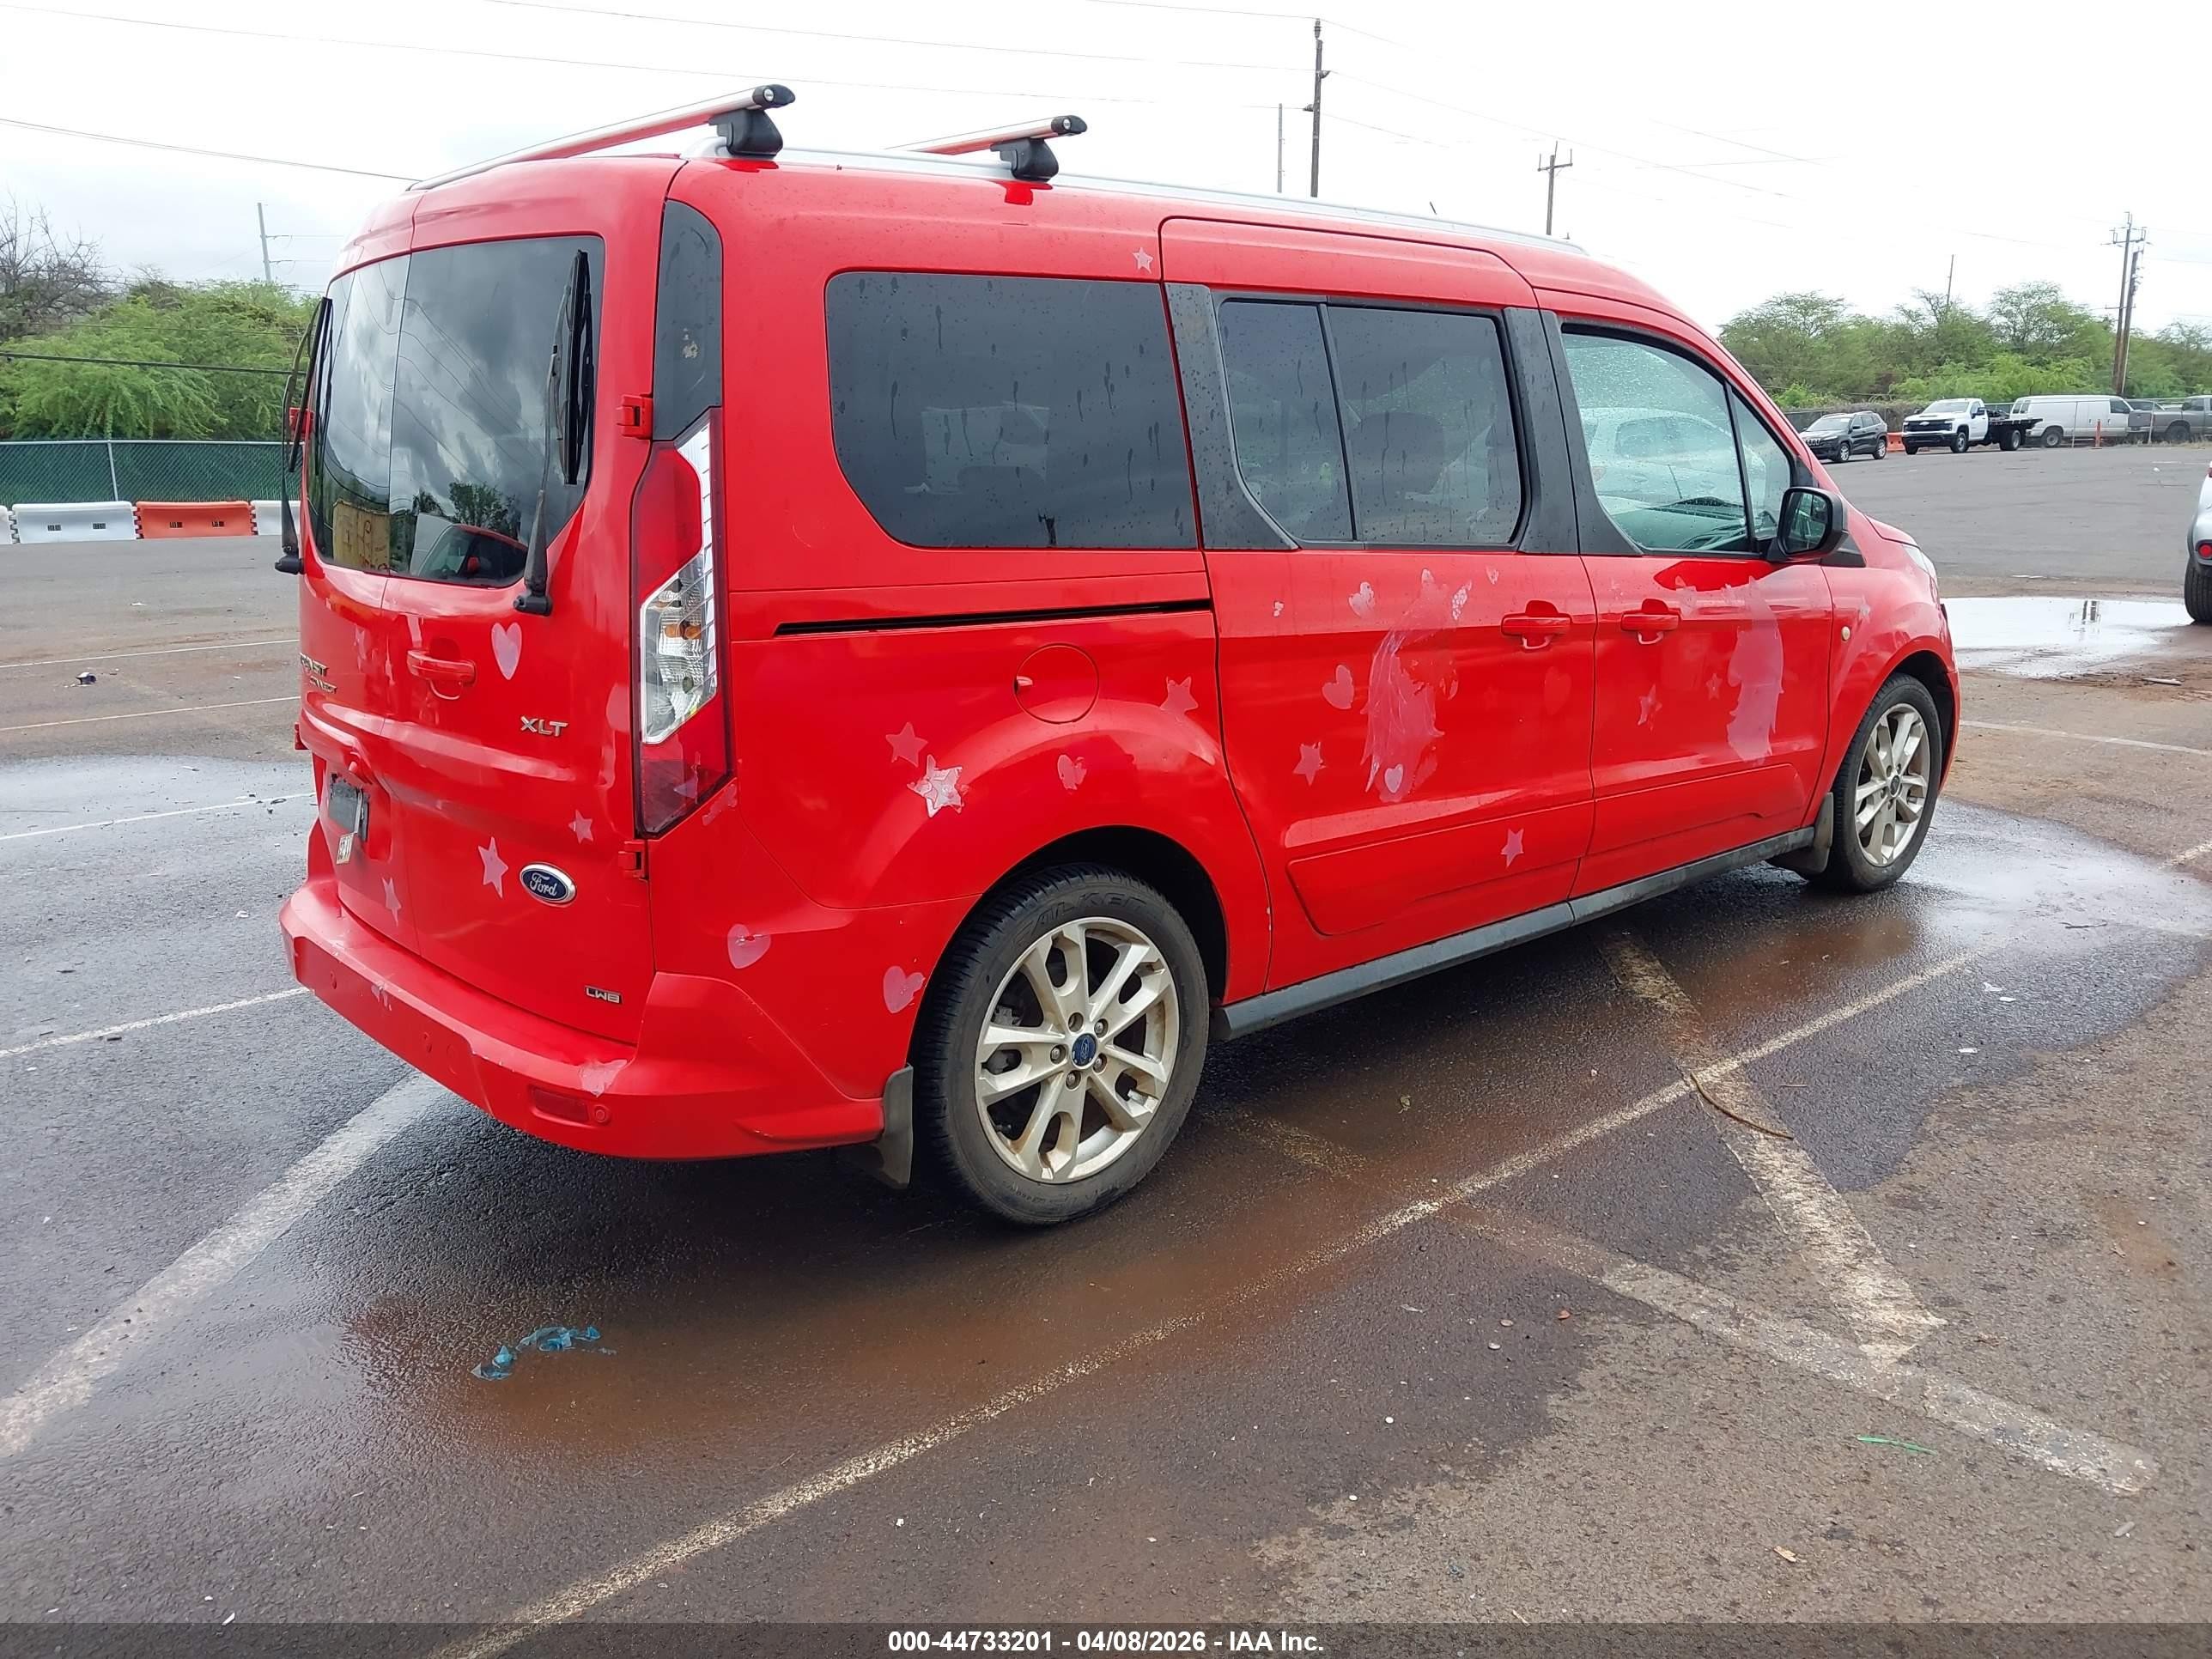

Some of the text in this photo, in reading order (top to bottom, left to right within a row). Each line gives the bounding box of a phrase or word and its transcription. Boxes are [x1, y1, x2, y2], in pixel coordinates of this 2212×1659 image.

[520, 715, 568, 737] XLT
[529, 872, 558, 896] Ford
[586, 987, 621, 1004] LWB
